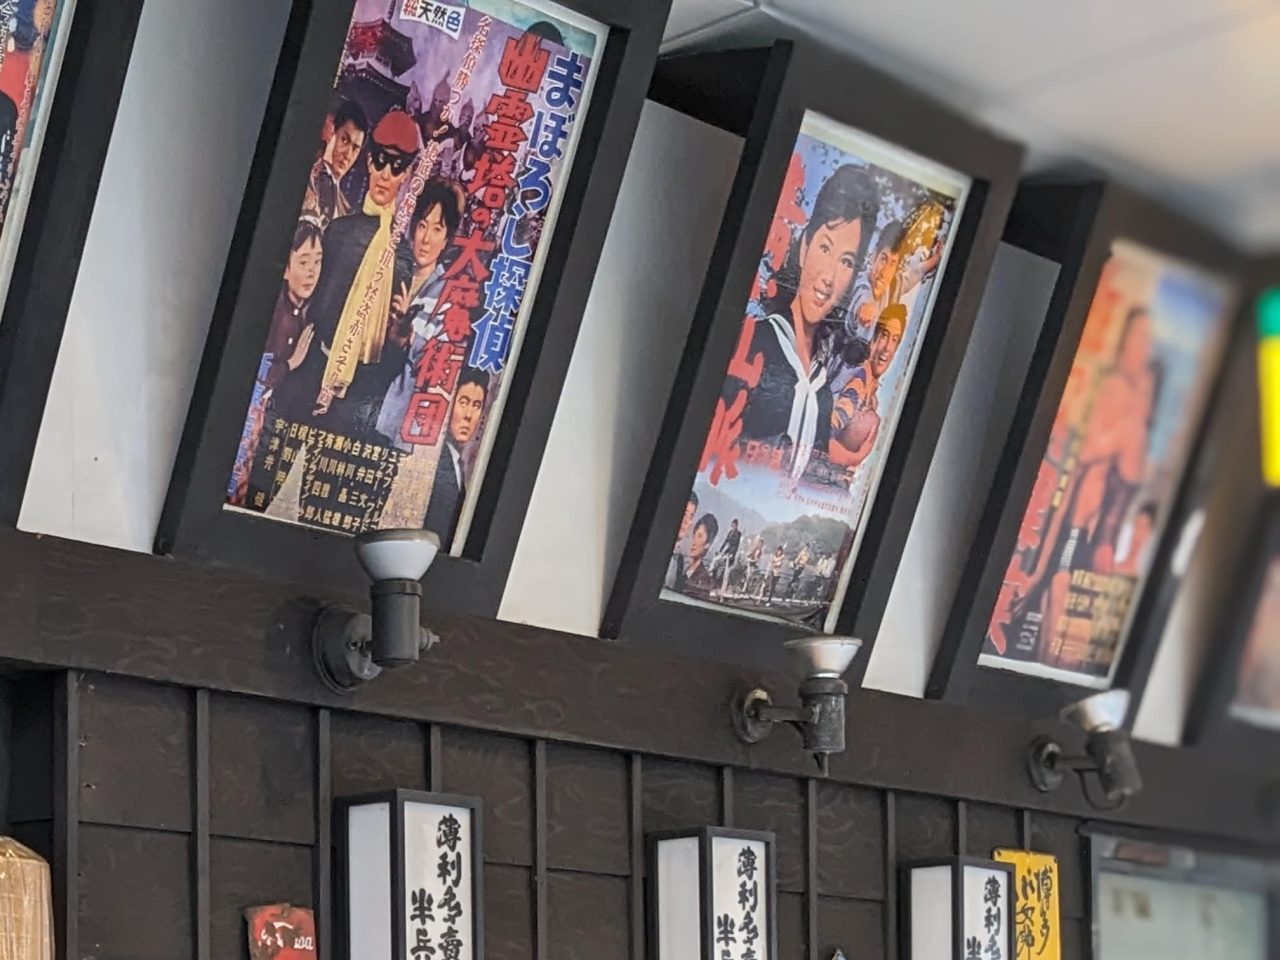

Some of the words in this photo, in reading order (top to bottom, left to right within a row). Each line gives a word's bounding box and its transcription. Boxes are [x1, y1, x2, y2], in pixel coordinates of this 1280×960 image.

[467, 50, 585, 373] まぼろし探偵
